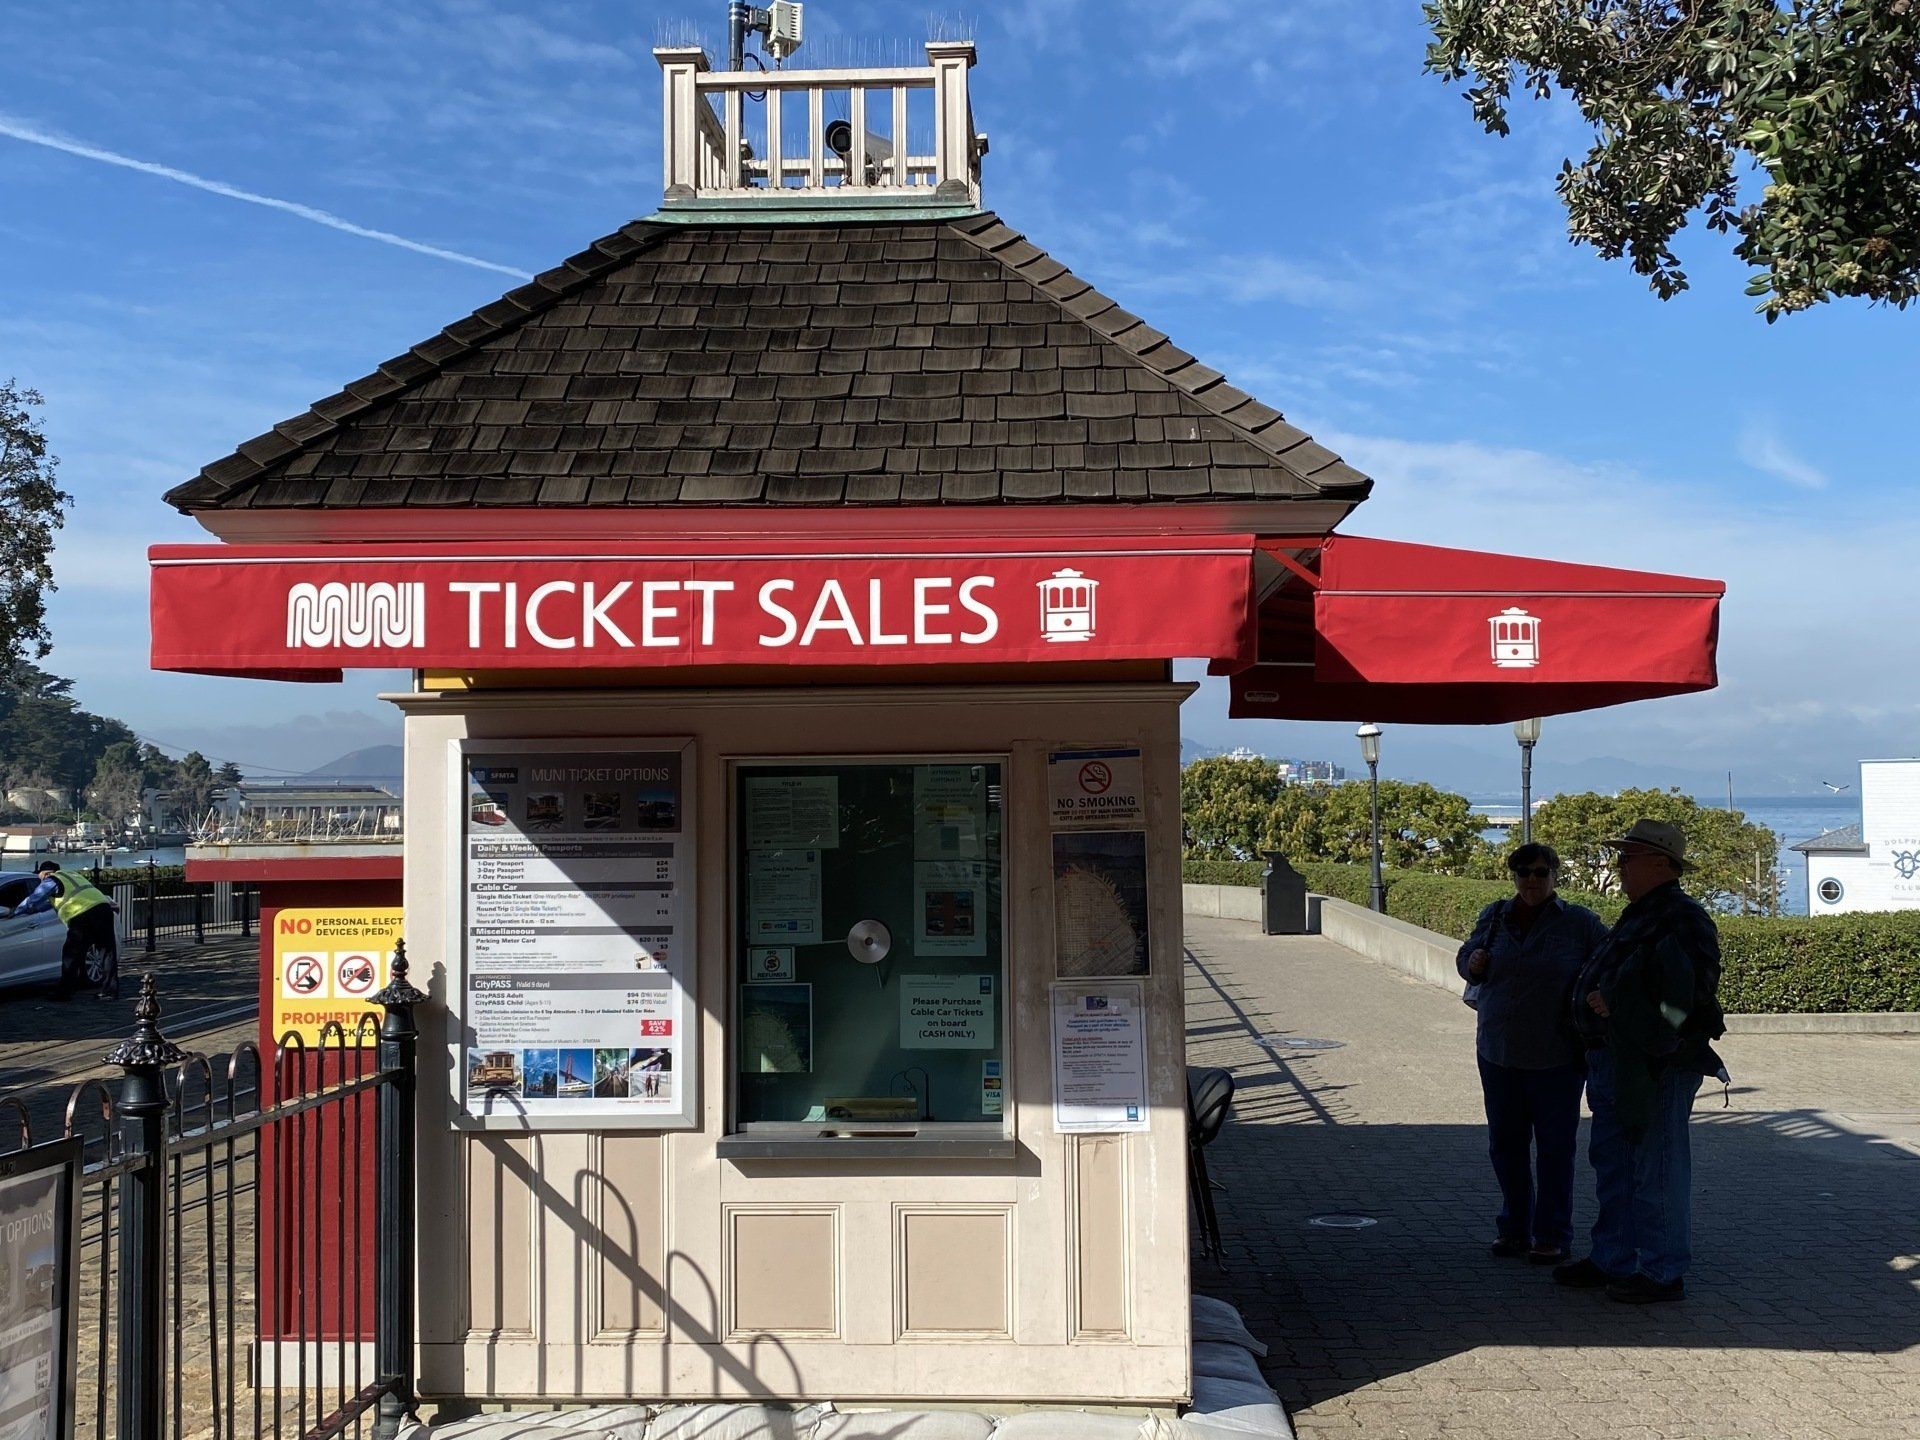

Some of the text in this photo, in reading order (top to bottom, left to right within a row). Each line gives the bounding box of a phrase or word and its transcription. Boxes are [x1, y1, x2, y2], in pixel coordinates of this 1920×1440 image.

[286, 575, 998, 648] MUNI TICKET SALES
[531, 768, 669, 782] MUNI TICKET OPTIONS
[1057, 796, 1136, 808] NO SMOKING
[478, 844, 498, 852] Daily
[510, 844, 538, 852] Weekly
[280, 919, 312, 934] NO
[362, 928, 393, 936] (PEDs)
[476, 980, 512, 990] CityPASS
[282, 1012, 383, 1024] PROHIBIT
[941, 1019, 966, 1027] board
[360, 1028, 376, 1036] ZO
[919, 1030, 975, 1039] (CASH ONLY)
[7, 1210, 52, 1244] OPTIONS
